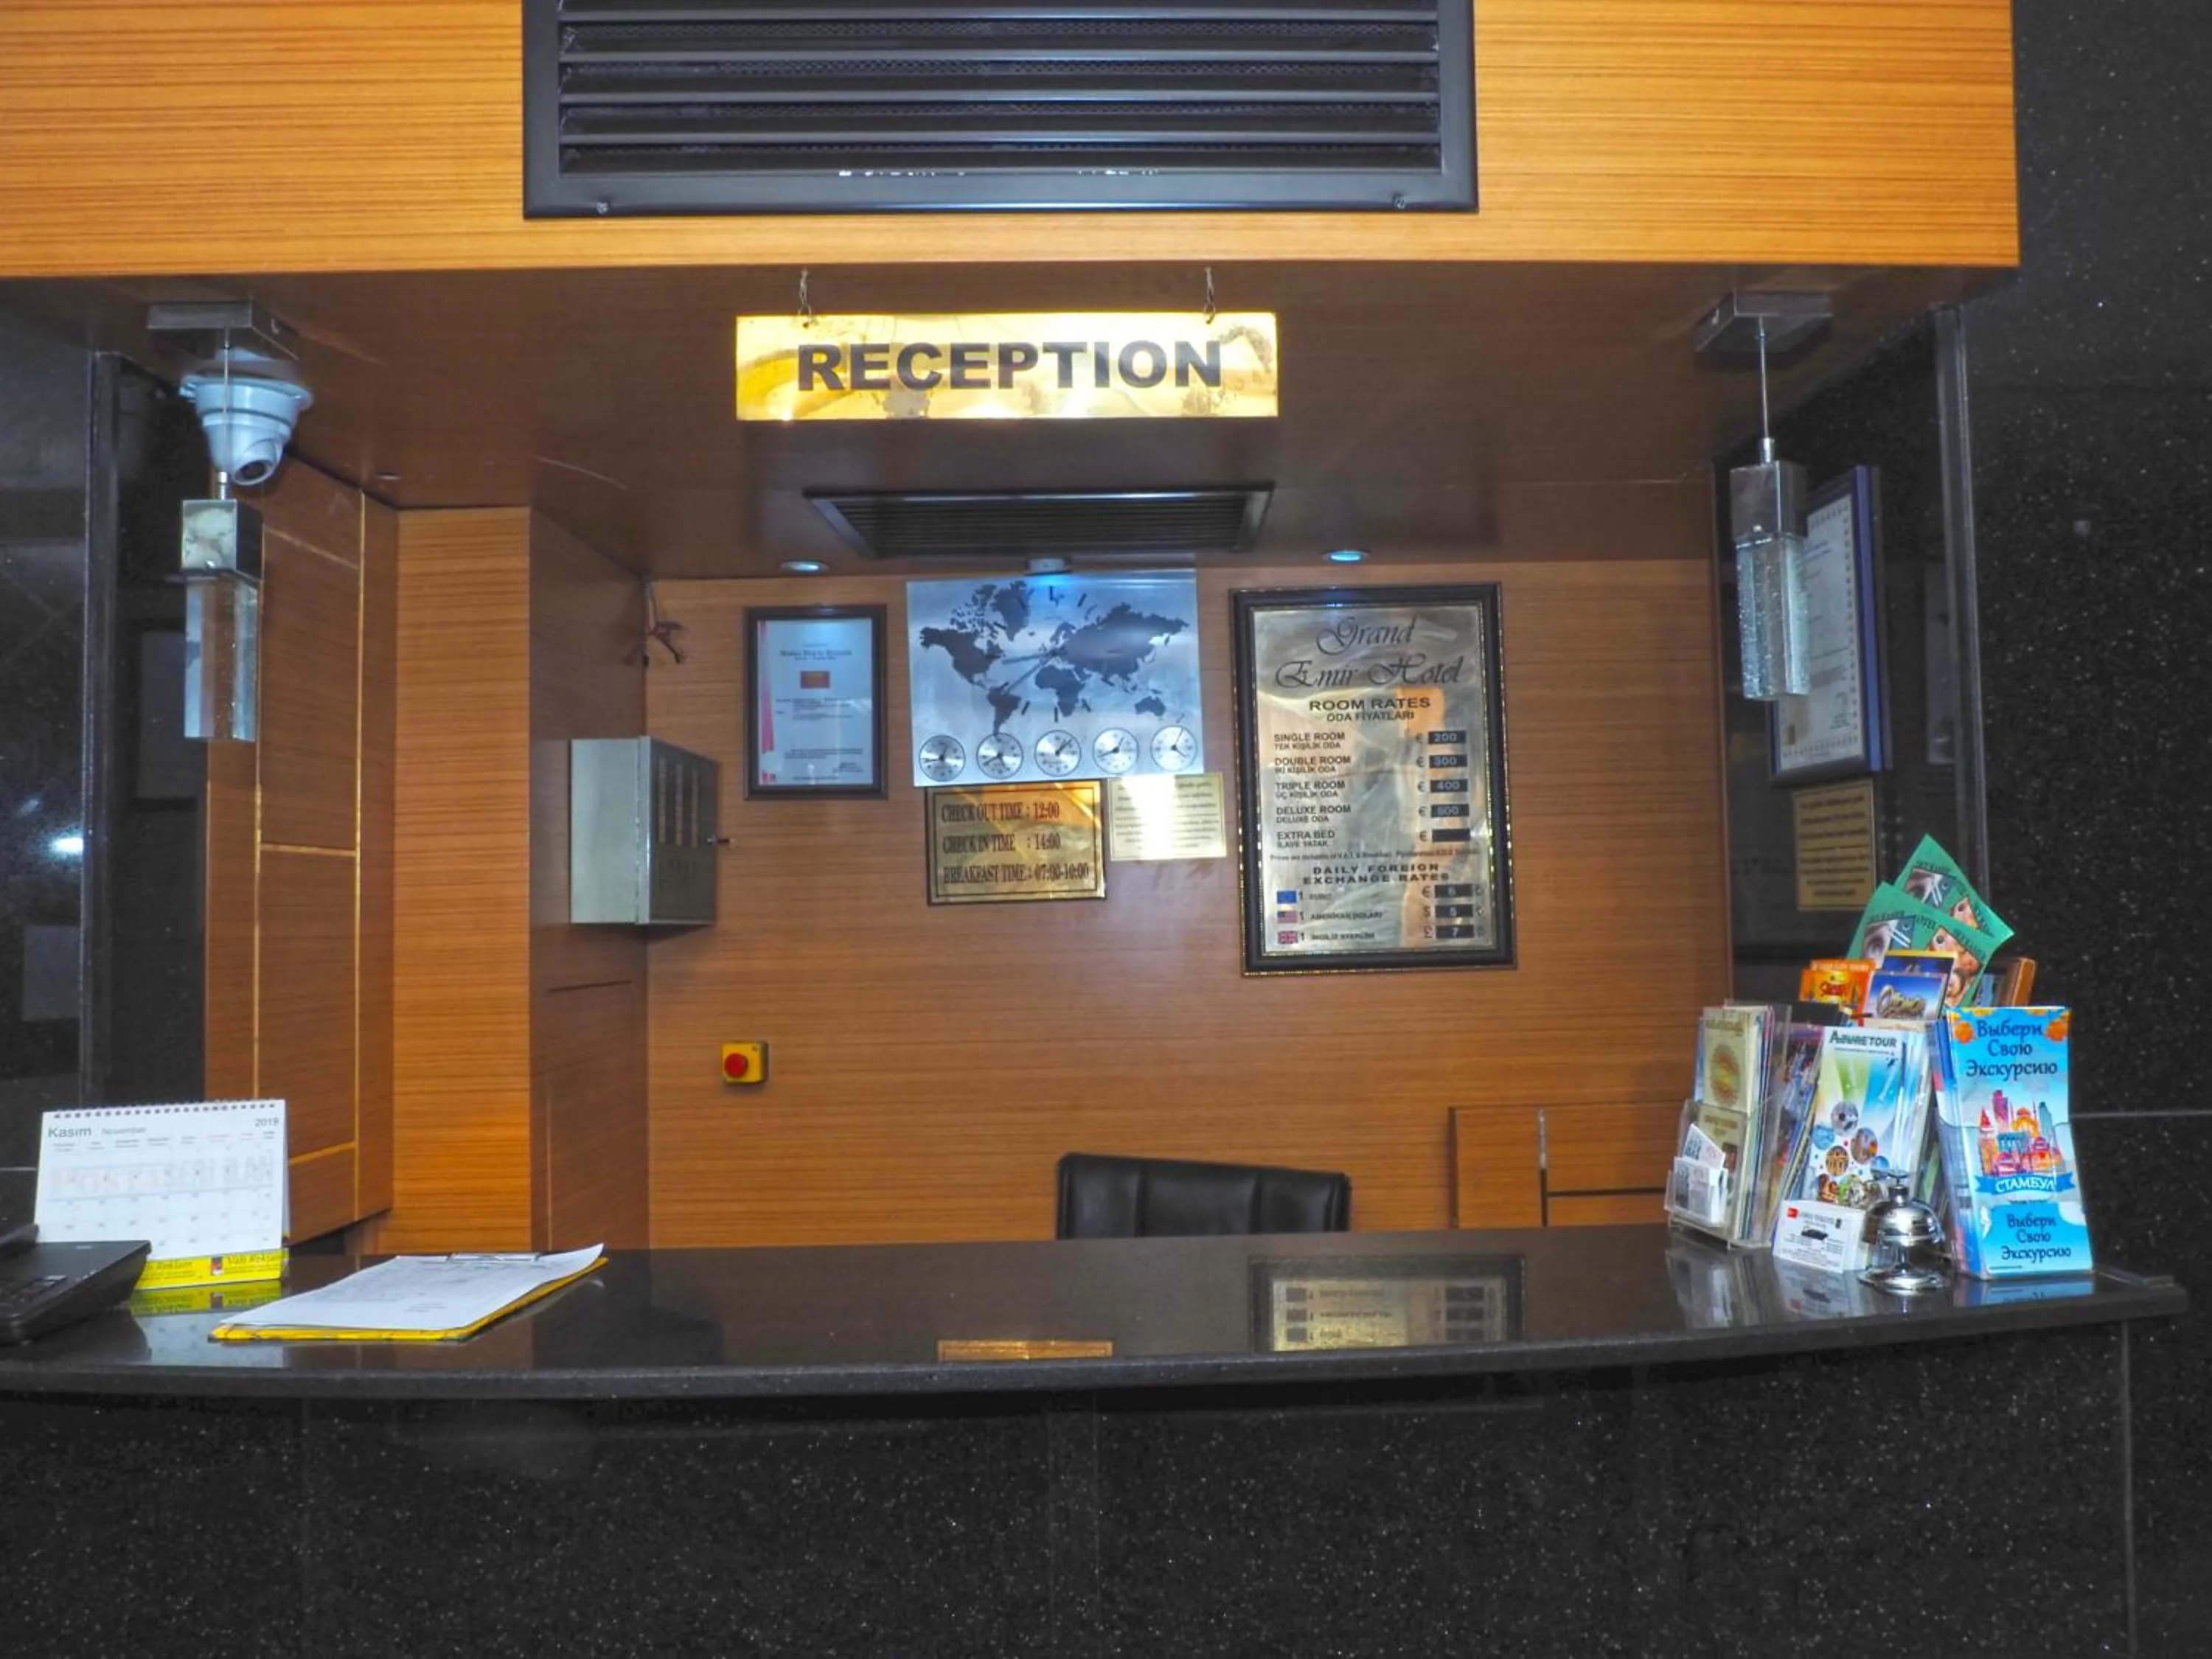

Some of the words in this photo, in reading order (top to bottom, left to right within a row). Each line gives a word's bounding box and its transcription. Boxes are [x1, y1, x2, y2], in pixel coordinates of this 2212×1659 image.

[798, 340, 1222, 391] RECEPTION
[1316, 615, 1417, 655] Grand
[1276, 660, 1358, 688] Emir
[1367, 653, 1464, 685] Hotel
[1310, 699, 1364, 711] ROOM
[1371, 697, 1431, 709] RATES
[1326, 712, 1352, 722] ODA
[1273, 732, 1312, 742] SINGLE
[1313, 731, 1346, 741] ROOM
[1434, 732, 1457, 742] 200
[1322, 741, 1341, 749] ODA
[1275, 756, 1316, 766] DOUBLE
[1318, 755, 1352, 765] ROOM
[1317, 765, 1336, 773] ODA
[1275, 782, 1312, 790] TRIPLE
[1313, 780, 1346, 789] ROOM
[1437, 781, 1460, 790] 400
[942, 803, 976, 823] CHECK
[977, 801, 998, 821] OUT
[998, 801, 1023, 820] TIME
[1033, 801, 1060, 820] 12:00
[1276, 805, 1317, 815] DELUXE
[1319, 804, 1352, 813] ROOM
[1276, 815, 1310, 824] DELUXE
[1311, 815, 1329, 823] ODA
[1276, 831, 1312, 840] EXTRA
[1313, 830, 1336, 838] BED
[943, 835, 977, 854] CHECK
[978, 834, 990, 852] IN
[991, 833, 1016, 852] TIME
[944, 864, 1000, 884] BREAKFAST
[1001, 863, 1026, 882] TIME
[1313, 865, 1359, 874] DAILY
[1367, 863, 1439, 873] FOREIGN
[1303, 874, 1390, 885] EXCHANGE
[1399, 872, 1450, 883] RATES
[1977, 1018, 2044, 1041] Выбери
[1988, 1039, 2034, 1057] Свою
[1965, 1059, 2059, 1082] Экскурсию
[255, 1117, 279, 1128] 2019
[102, 1127, 147, 1136] November
[1994, 1175, 2056, 1193] СТАМБУЛ
[2006, 1212, 2058, 1229] Выбери
[2017, 1229, 2052, 1244] Свою
[2000, 1245, 2073, 1264] Экскурсию
